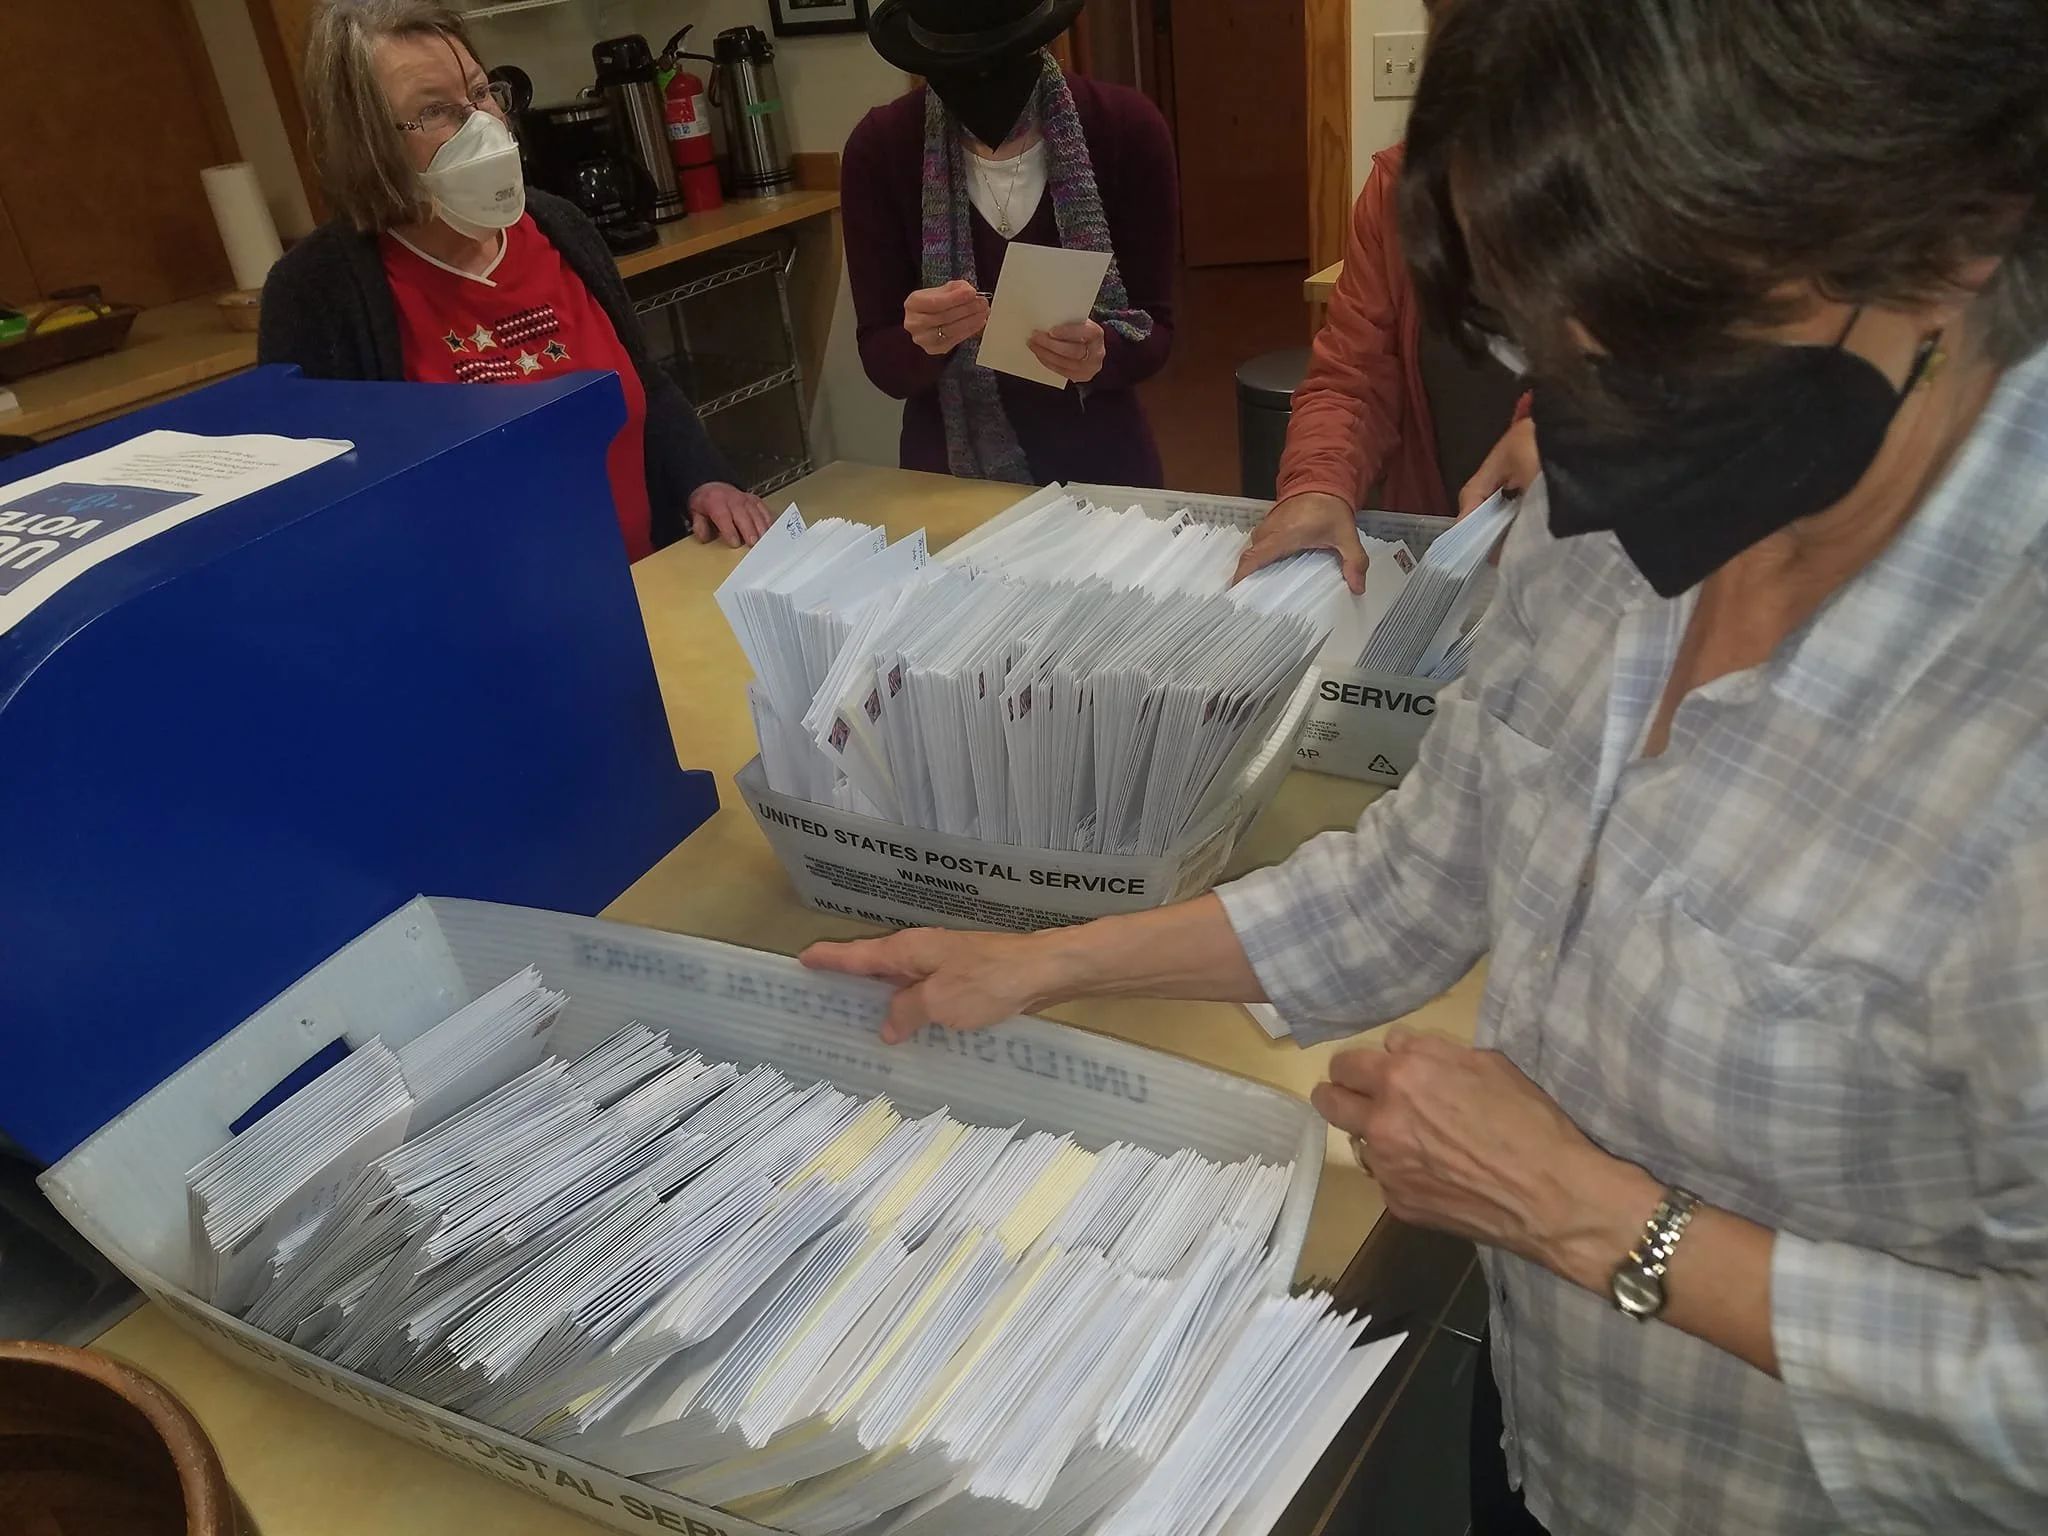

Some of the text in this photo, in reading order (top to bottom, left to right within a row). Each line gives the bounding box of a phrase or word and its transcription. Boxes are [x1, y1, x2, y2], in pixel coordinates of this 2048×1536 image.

[1319, 680, 1436, 716] SERVIC
[758, 802, 1145, 895] UNITED STATES POSTAL SERVICE
[896, 868, 980, 896] WARNING
[814, 897, 853, 915] HALF
[885, 916, 929, 928] TRA
[435, 1420, 614, 1507] POSTAL
[620, 1494, 729, 1536] SER
